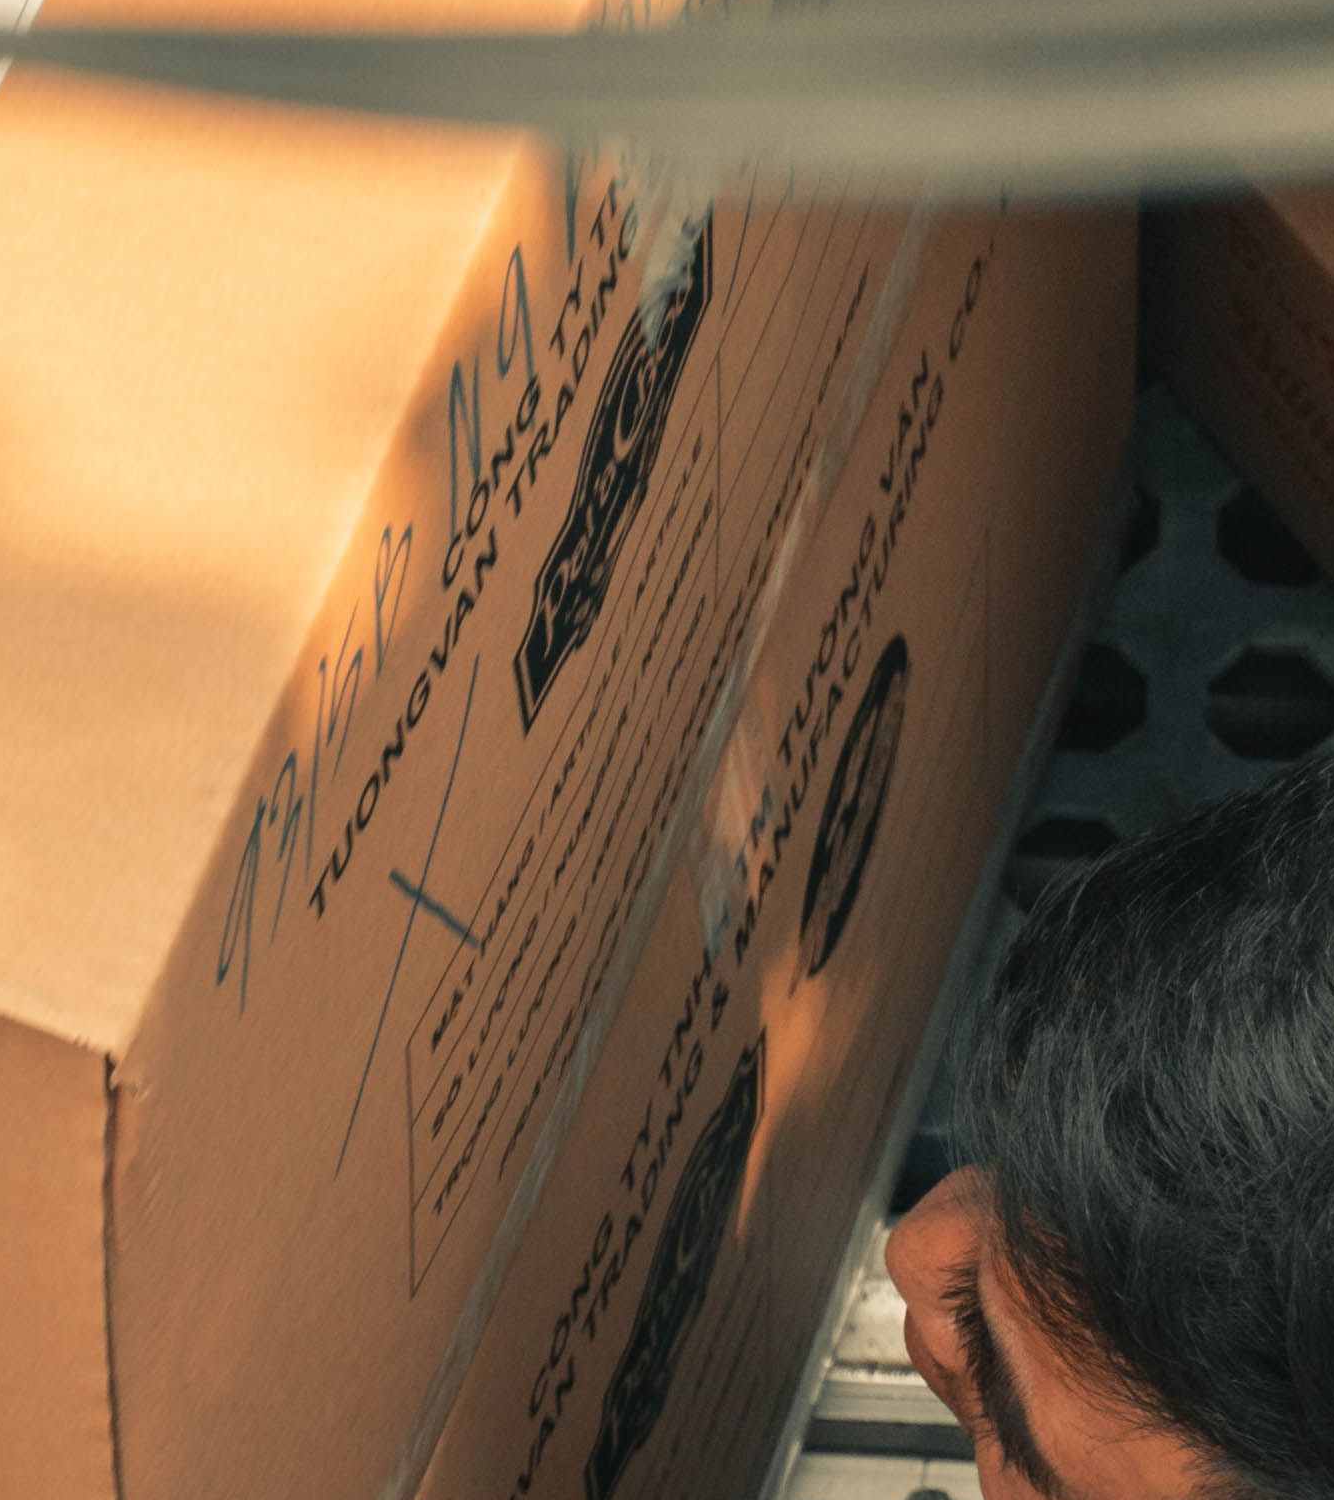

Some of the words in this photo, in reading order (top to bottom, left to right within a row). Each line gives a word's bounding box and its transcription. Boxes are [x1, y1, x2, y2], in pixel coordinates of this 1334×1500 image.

[548, 256, 584, 364] TY
[307, 522, 499, 921] TUONGVAN
[505, 197, 640, 521] TRADING
[583, 1043, 703, 1340] TRADING
[735, 372, 943, 966] MANUFACTURING
[621, 1100, 651, 1190] TY
